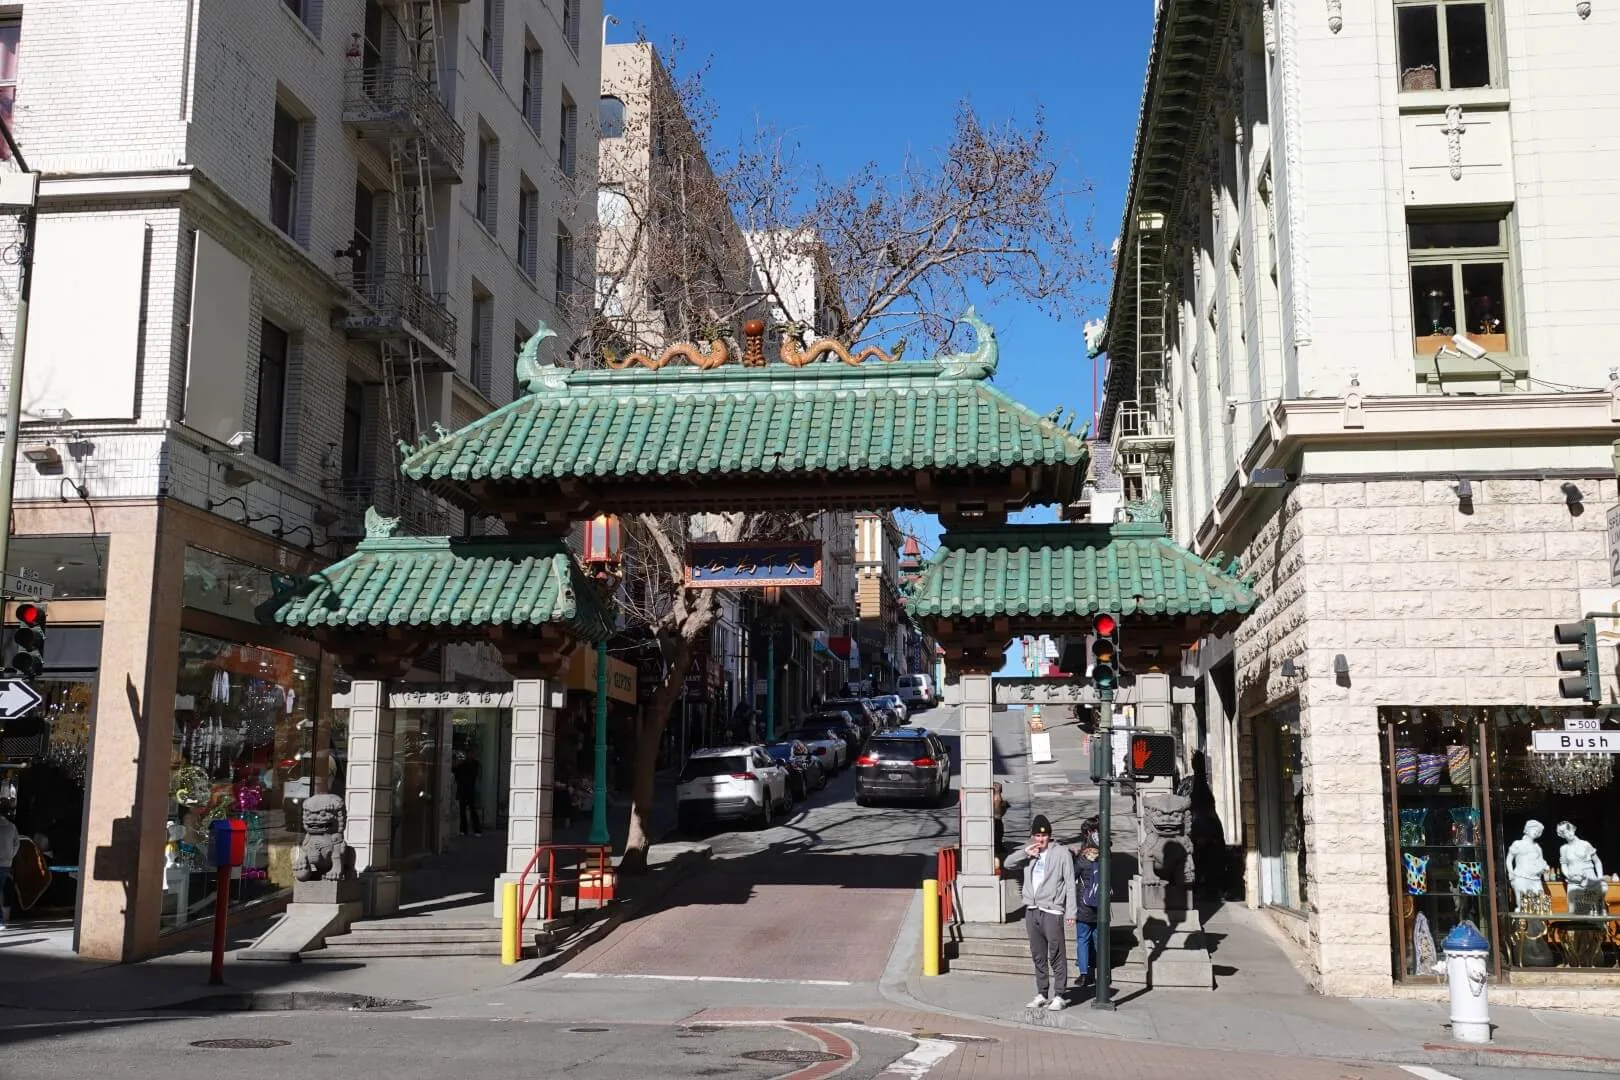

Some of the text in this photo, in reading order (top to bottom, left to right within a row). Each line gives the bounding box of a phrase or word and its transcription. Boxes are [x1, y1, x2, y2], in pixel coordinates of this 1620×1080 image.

[16, 580, 42, 596] Grant
[1578, 721, 1597, 729] 500
[1561, 736, 1608, 747] Bush
